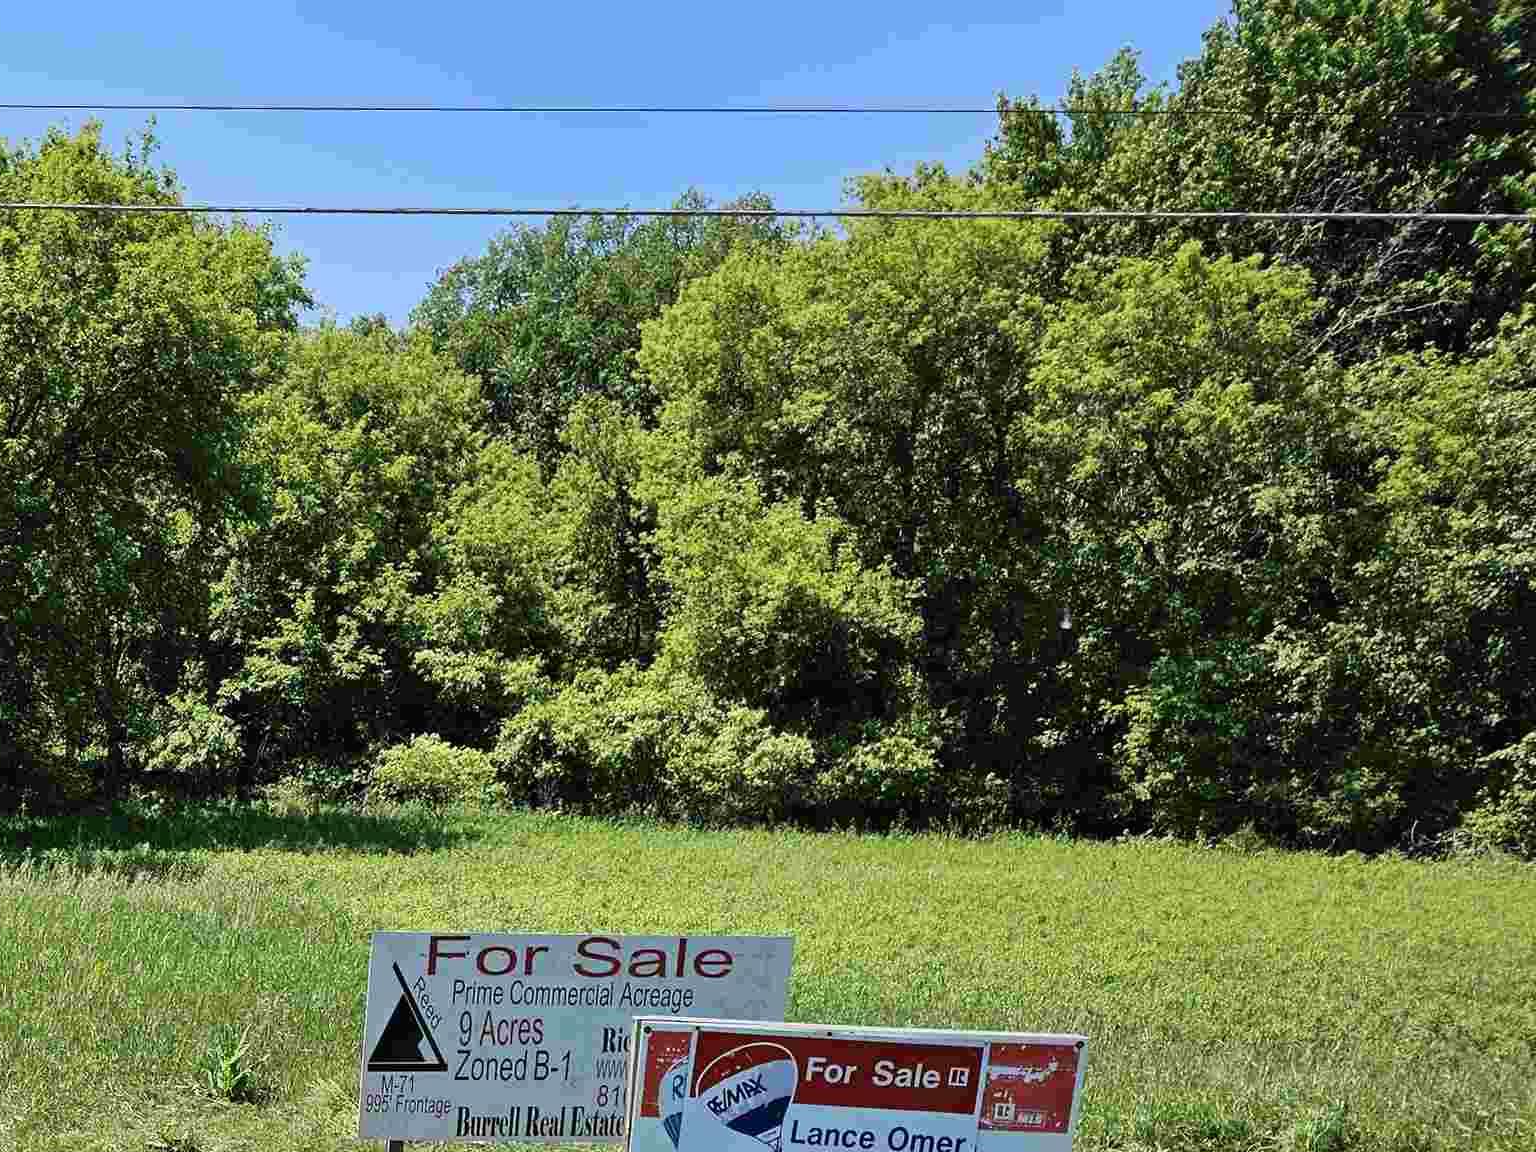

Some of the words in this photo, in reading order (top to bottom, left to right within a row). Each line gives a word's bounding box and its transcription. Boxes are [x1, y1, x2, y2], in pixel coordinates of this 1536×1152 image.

[424, 935, 550, 976] For
[573, 936, 734, 979] Sale
[413, 976, 442, 1030] Reed
[453, 980, 504, 1006] Prime
[510, 980, 614, 1006] Commercial
[620, 981, 694, 1013] Acreage
[459, 1011, 473, 1046] 9
[480, 1011, 544, 1046] Acres
[454, 1049, 527, 1081] Zoned
[533, 1050, 572, 1081] B-1
[805, 1057, 857, 1085] For
[872, 1060, 941, 1089] Sale
[381, 1075, 416, 1094] M-71
[707, 1074, 767, 1116] RE/MAX
[395, 1095, 452, 1119] Frontage
[456, 1106, 520, 1137] Burrell
[526, 1106, 564, 1137] Real
[570, 1106, 625, 1137] Estate
[790, 1120, 875, 1149] Lance
